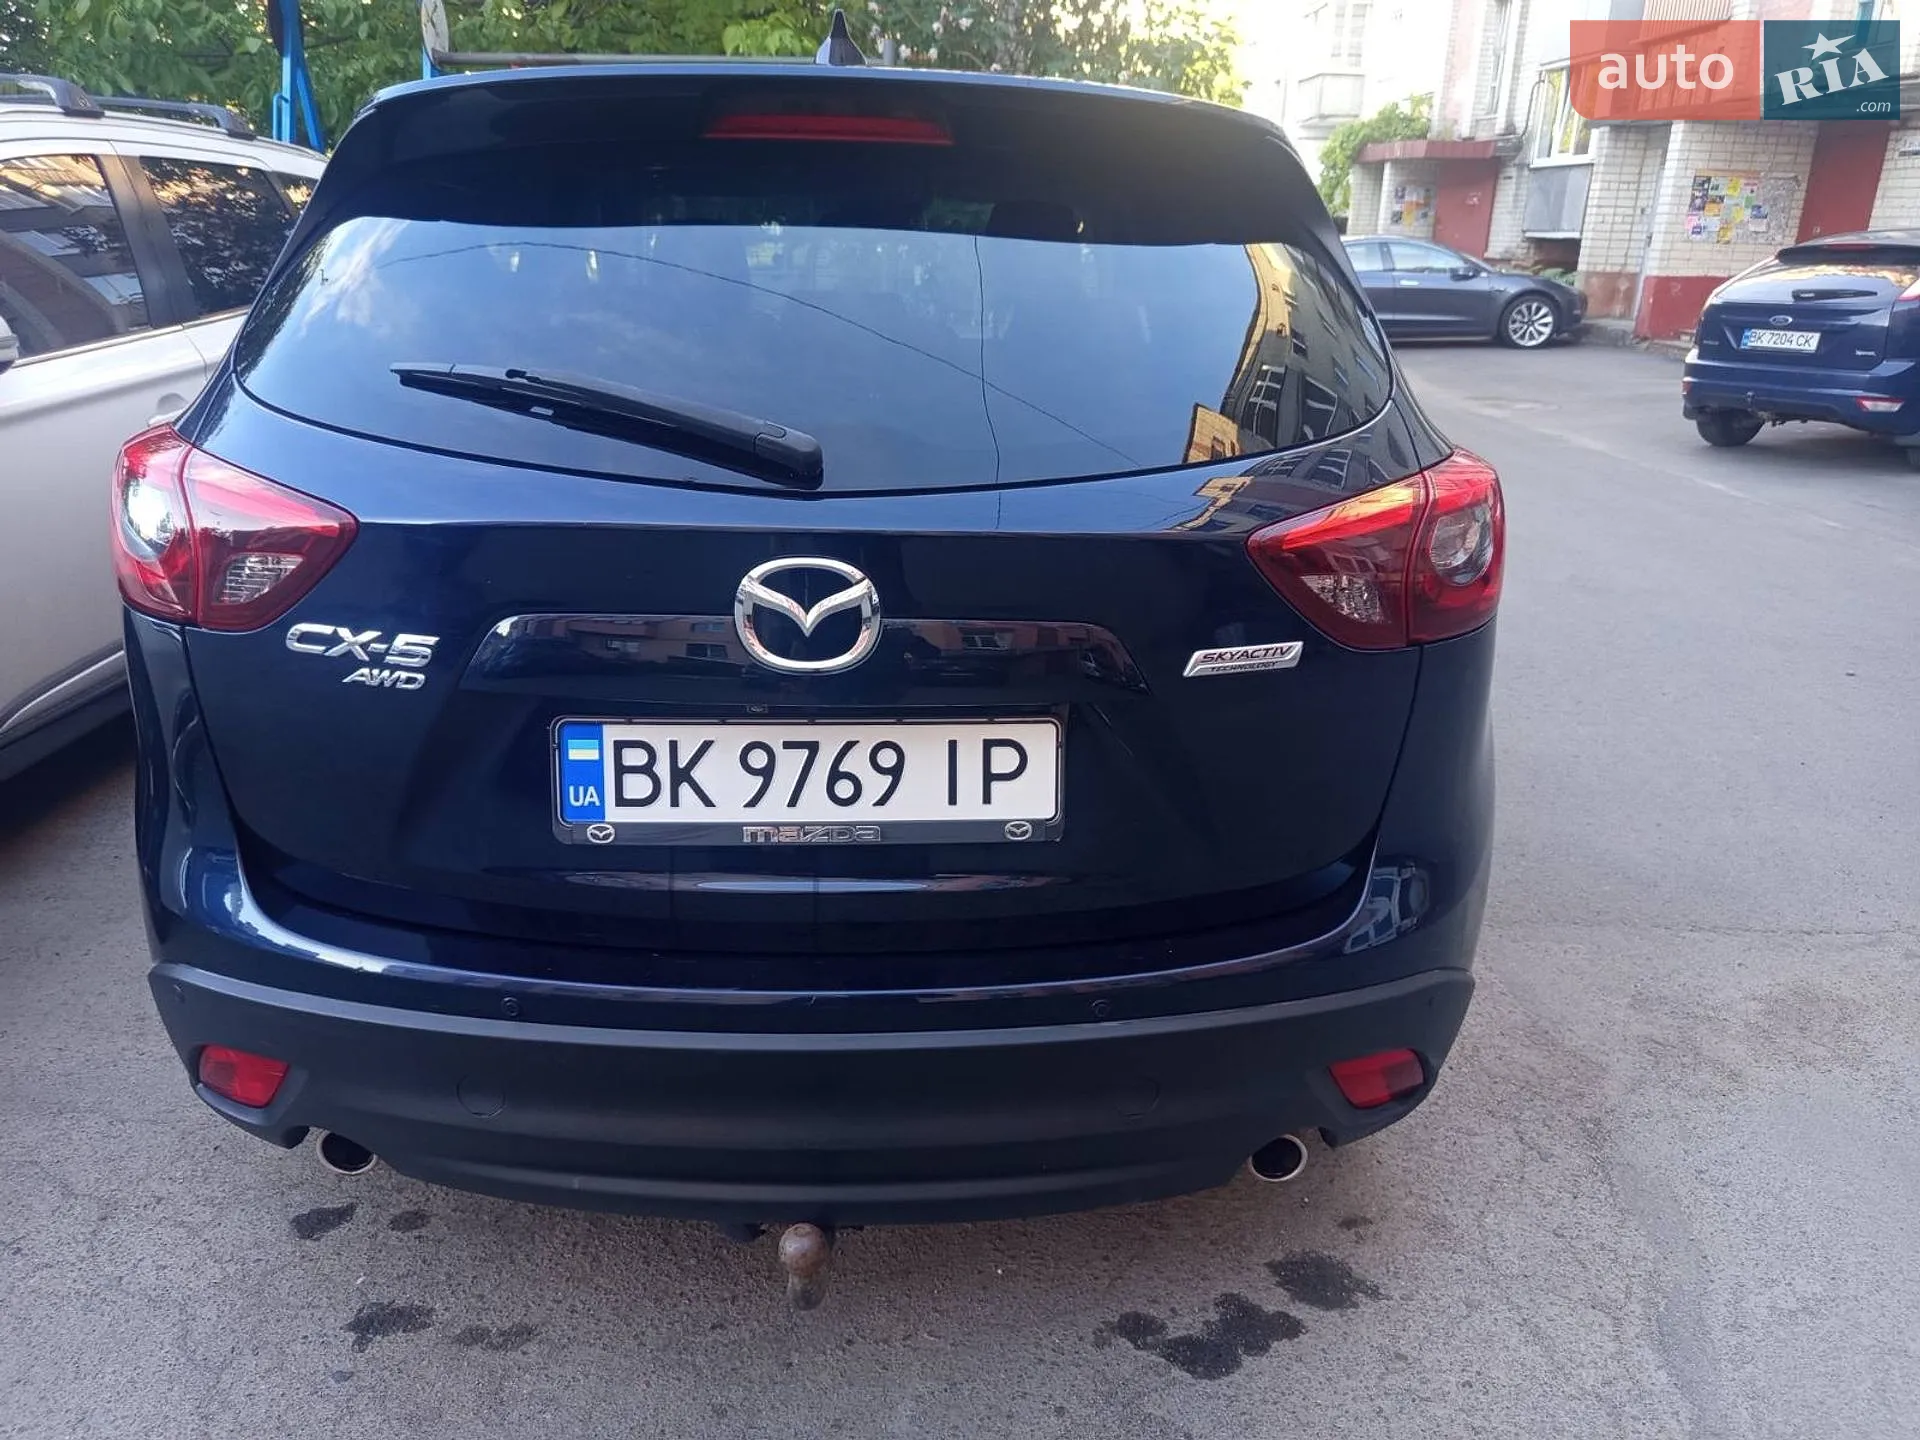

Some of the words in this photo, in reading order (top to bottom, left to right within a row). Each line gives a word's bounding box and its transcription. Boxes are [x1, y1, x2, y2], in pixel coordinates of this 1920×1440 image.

[1748, 331, 1766, 345] BK
[1767, 332, 1794, 346] 7204
[1796, 334, 1815, 348] CK
[285, 622, 441, 668] CX-5
[1200, 646, 1293, 664] SKYACTIV
[1210, 660, 1279, 673] TECHNOLOGY
[341, 667, 426, 691] AWD
[612, 739, 717, 809] BK
[738, 739, 906, 808] 9769
[947, 737, 1029, 806] IP
[568, 785, 601, 807] UA
